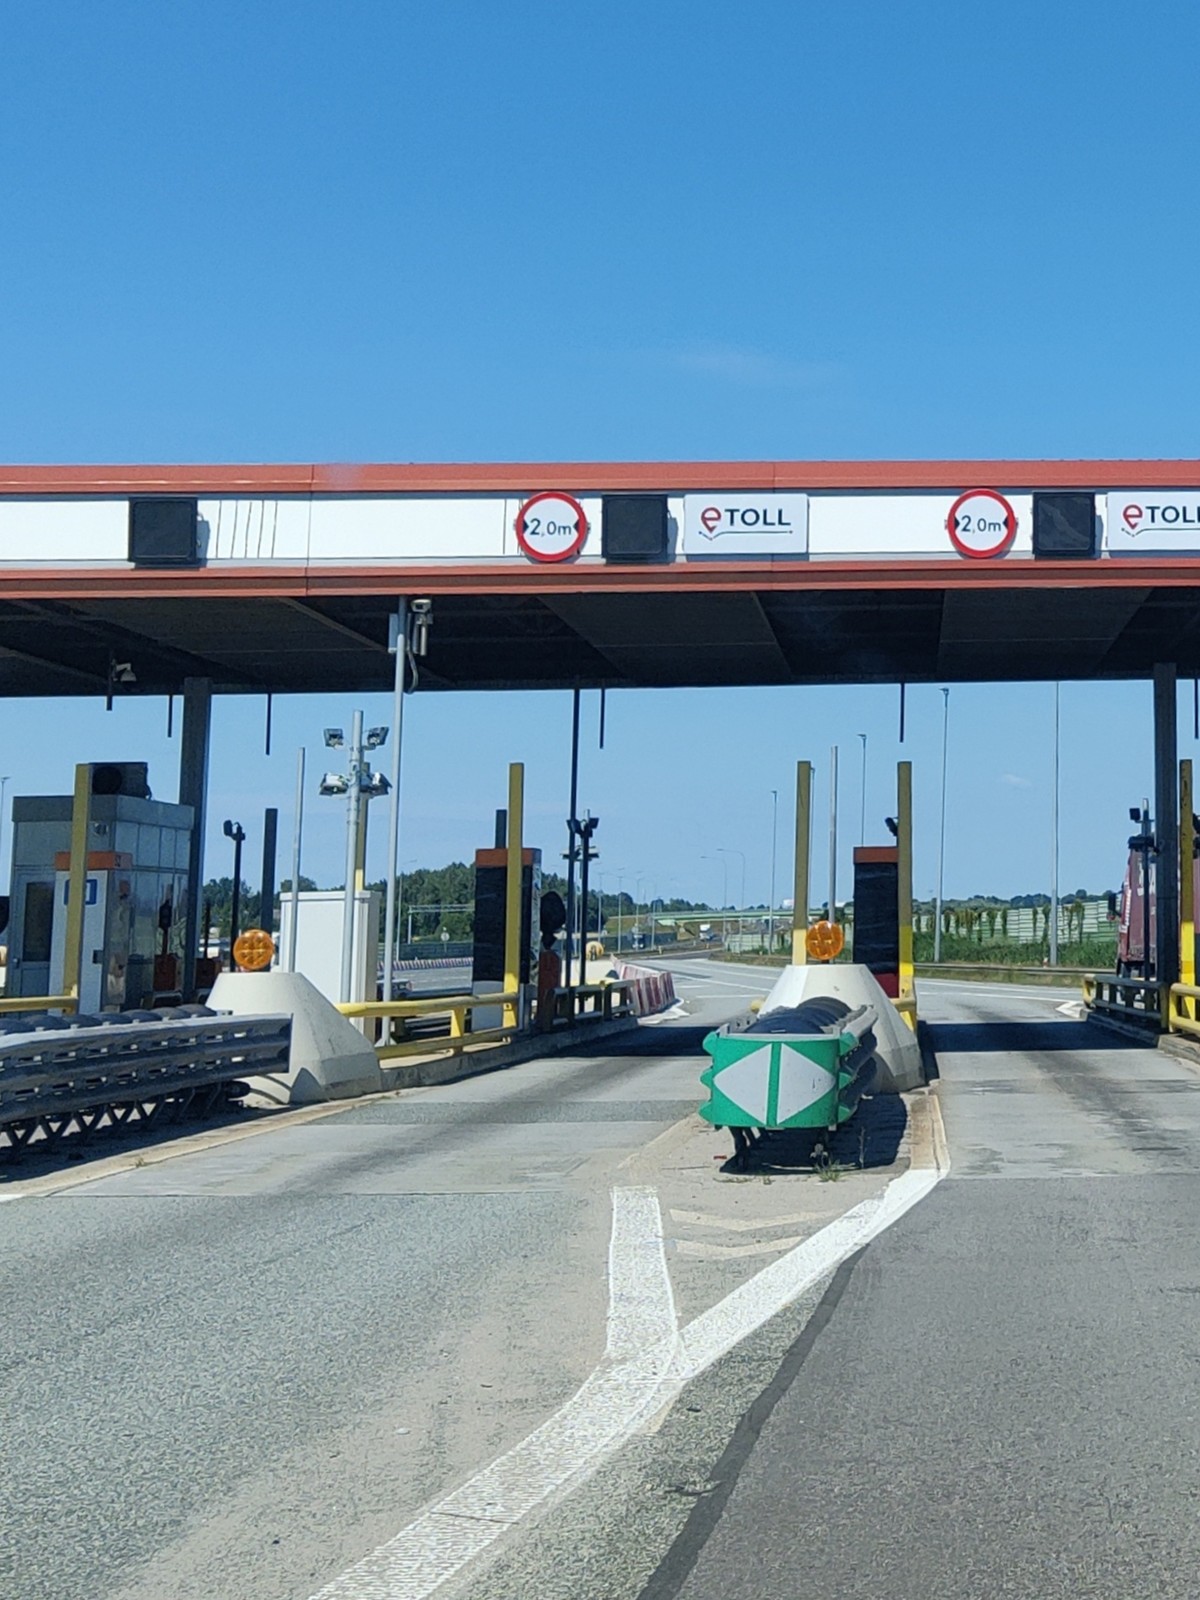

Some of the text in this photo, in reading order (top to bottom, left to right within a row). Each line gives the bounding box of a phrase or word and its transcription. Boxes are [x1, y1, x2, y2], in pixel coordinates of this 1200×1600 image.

[530, 518, 572, 536] 2,0m
[701, 507, 791, 533] eTOLL
[960, 515, 1002, 534] 2,0m
